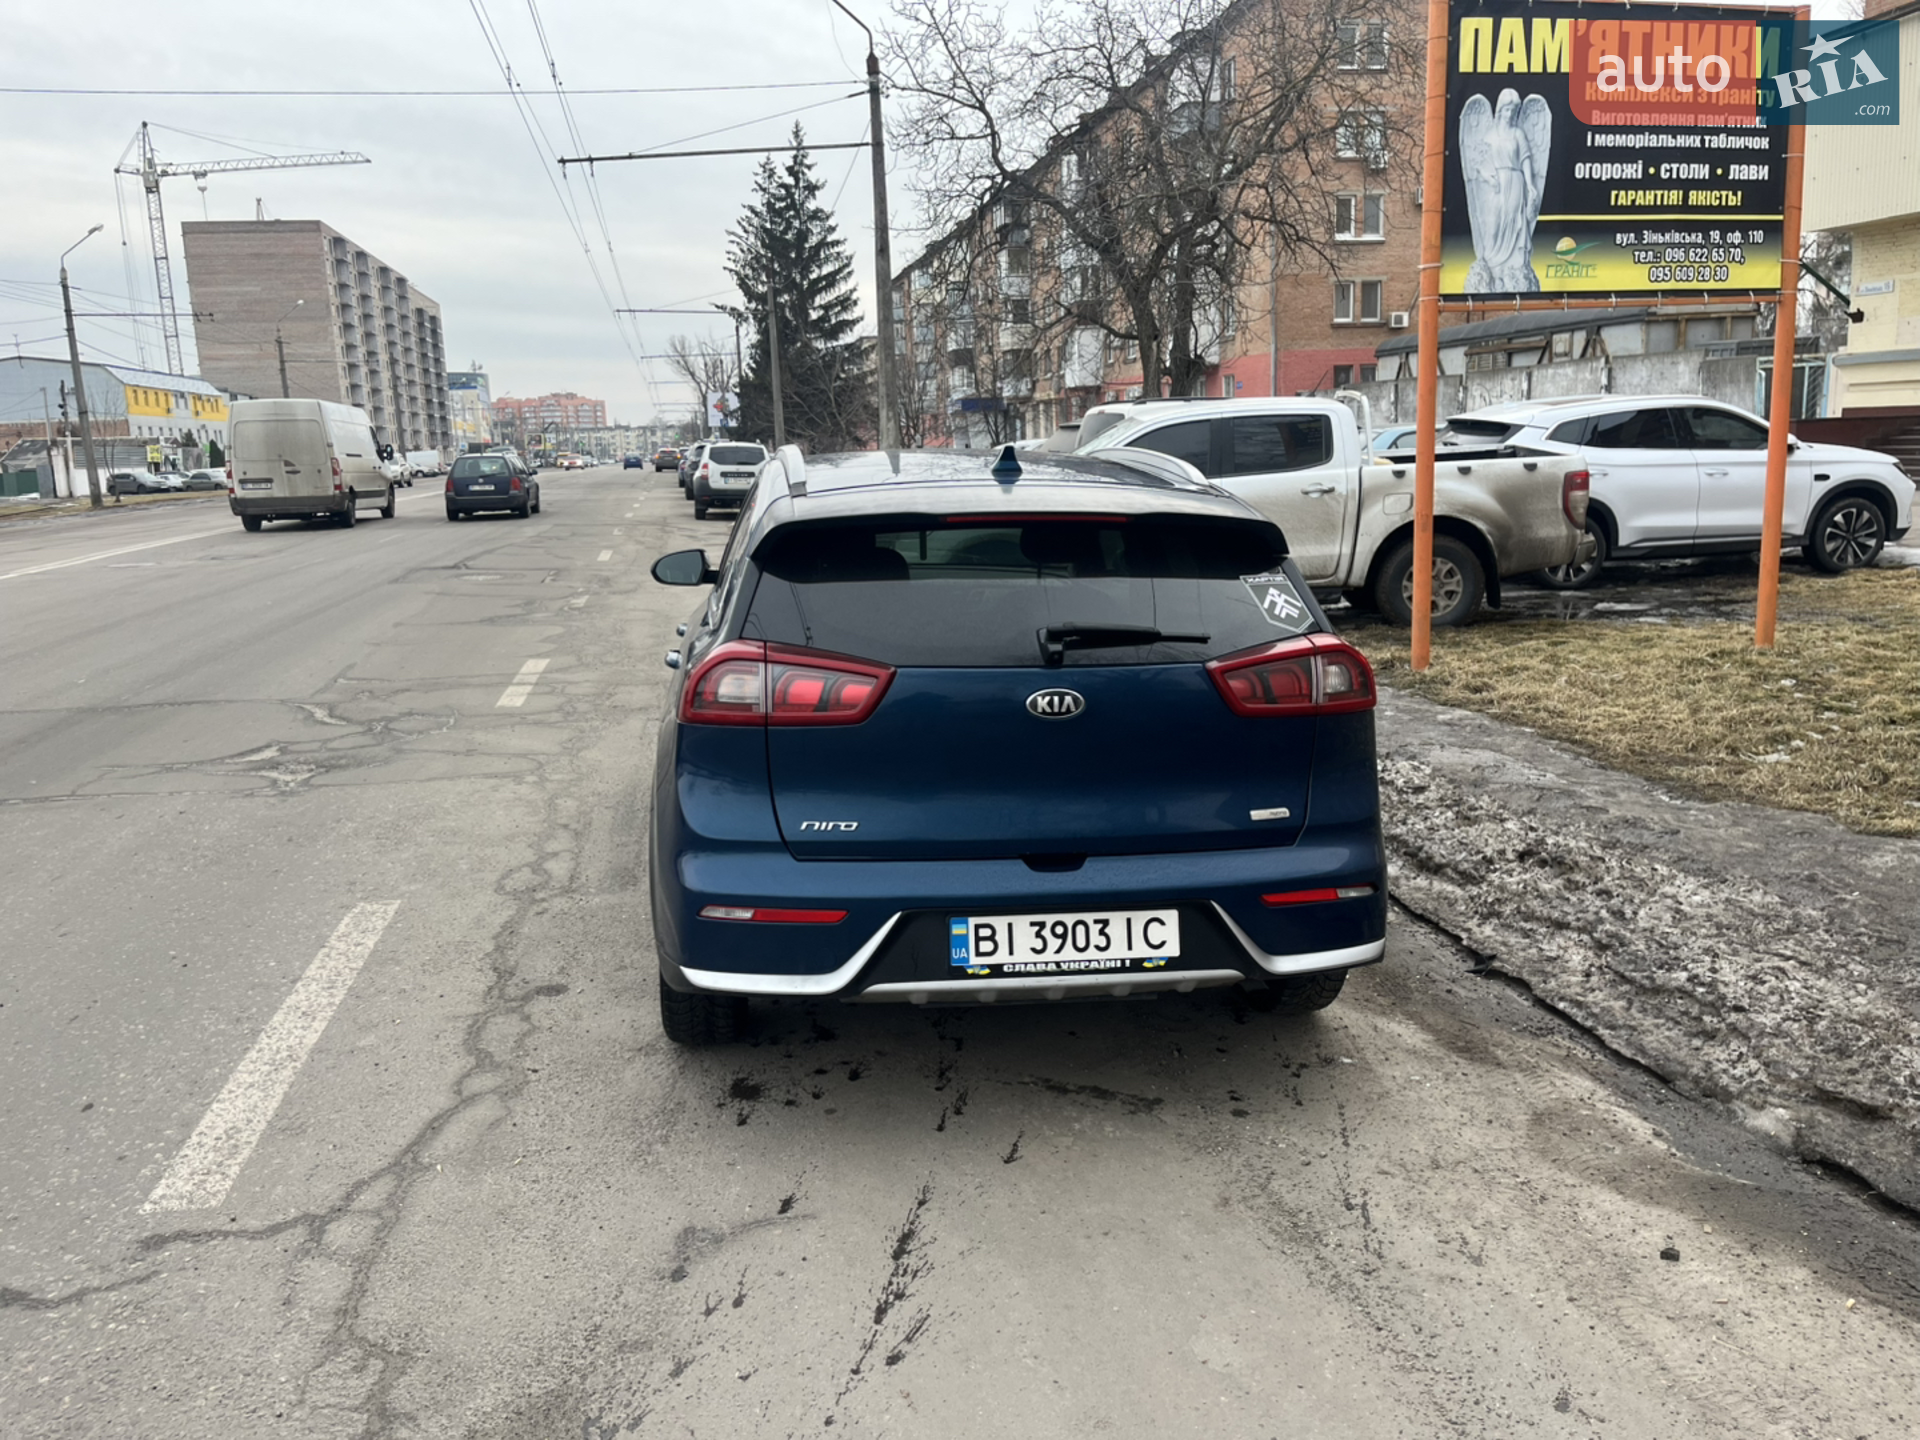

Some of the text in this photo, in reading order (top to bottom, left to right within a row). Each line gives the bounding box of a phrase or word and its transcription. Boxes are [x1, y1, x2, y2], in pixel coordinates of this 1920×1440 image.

[1591, 110, 1695, 127] Виготовлення
[1594, 131, 1702, 149] меморіальних
[1703, 132, 1770, 149] табличок
[1574, 160, 1769, 181] огорожі столи лави
[1610, 189, 1743, 207] ГАРАНТІЯ! ЯКІСТЬ!
[1615, 230, 1764, 247] вул. Зіньківська, 19, оф. 110
[1664, 248, 1685, 263] 096
[1688, 248, 1709, 263] 622
[1711, 249, 1726, 263] 65
[1728, 248, 1746, 264] 70,
[1650, 267, 1729, 281] 095 609 28 30
[1036, 695, 1077, 713] KIA
[1028, 918, 1112, 955] 3903
[951, 948, 968, 960] UA
[1002, 962, 1059, 973] СЛАВА
